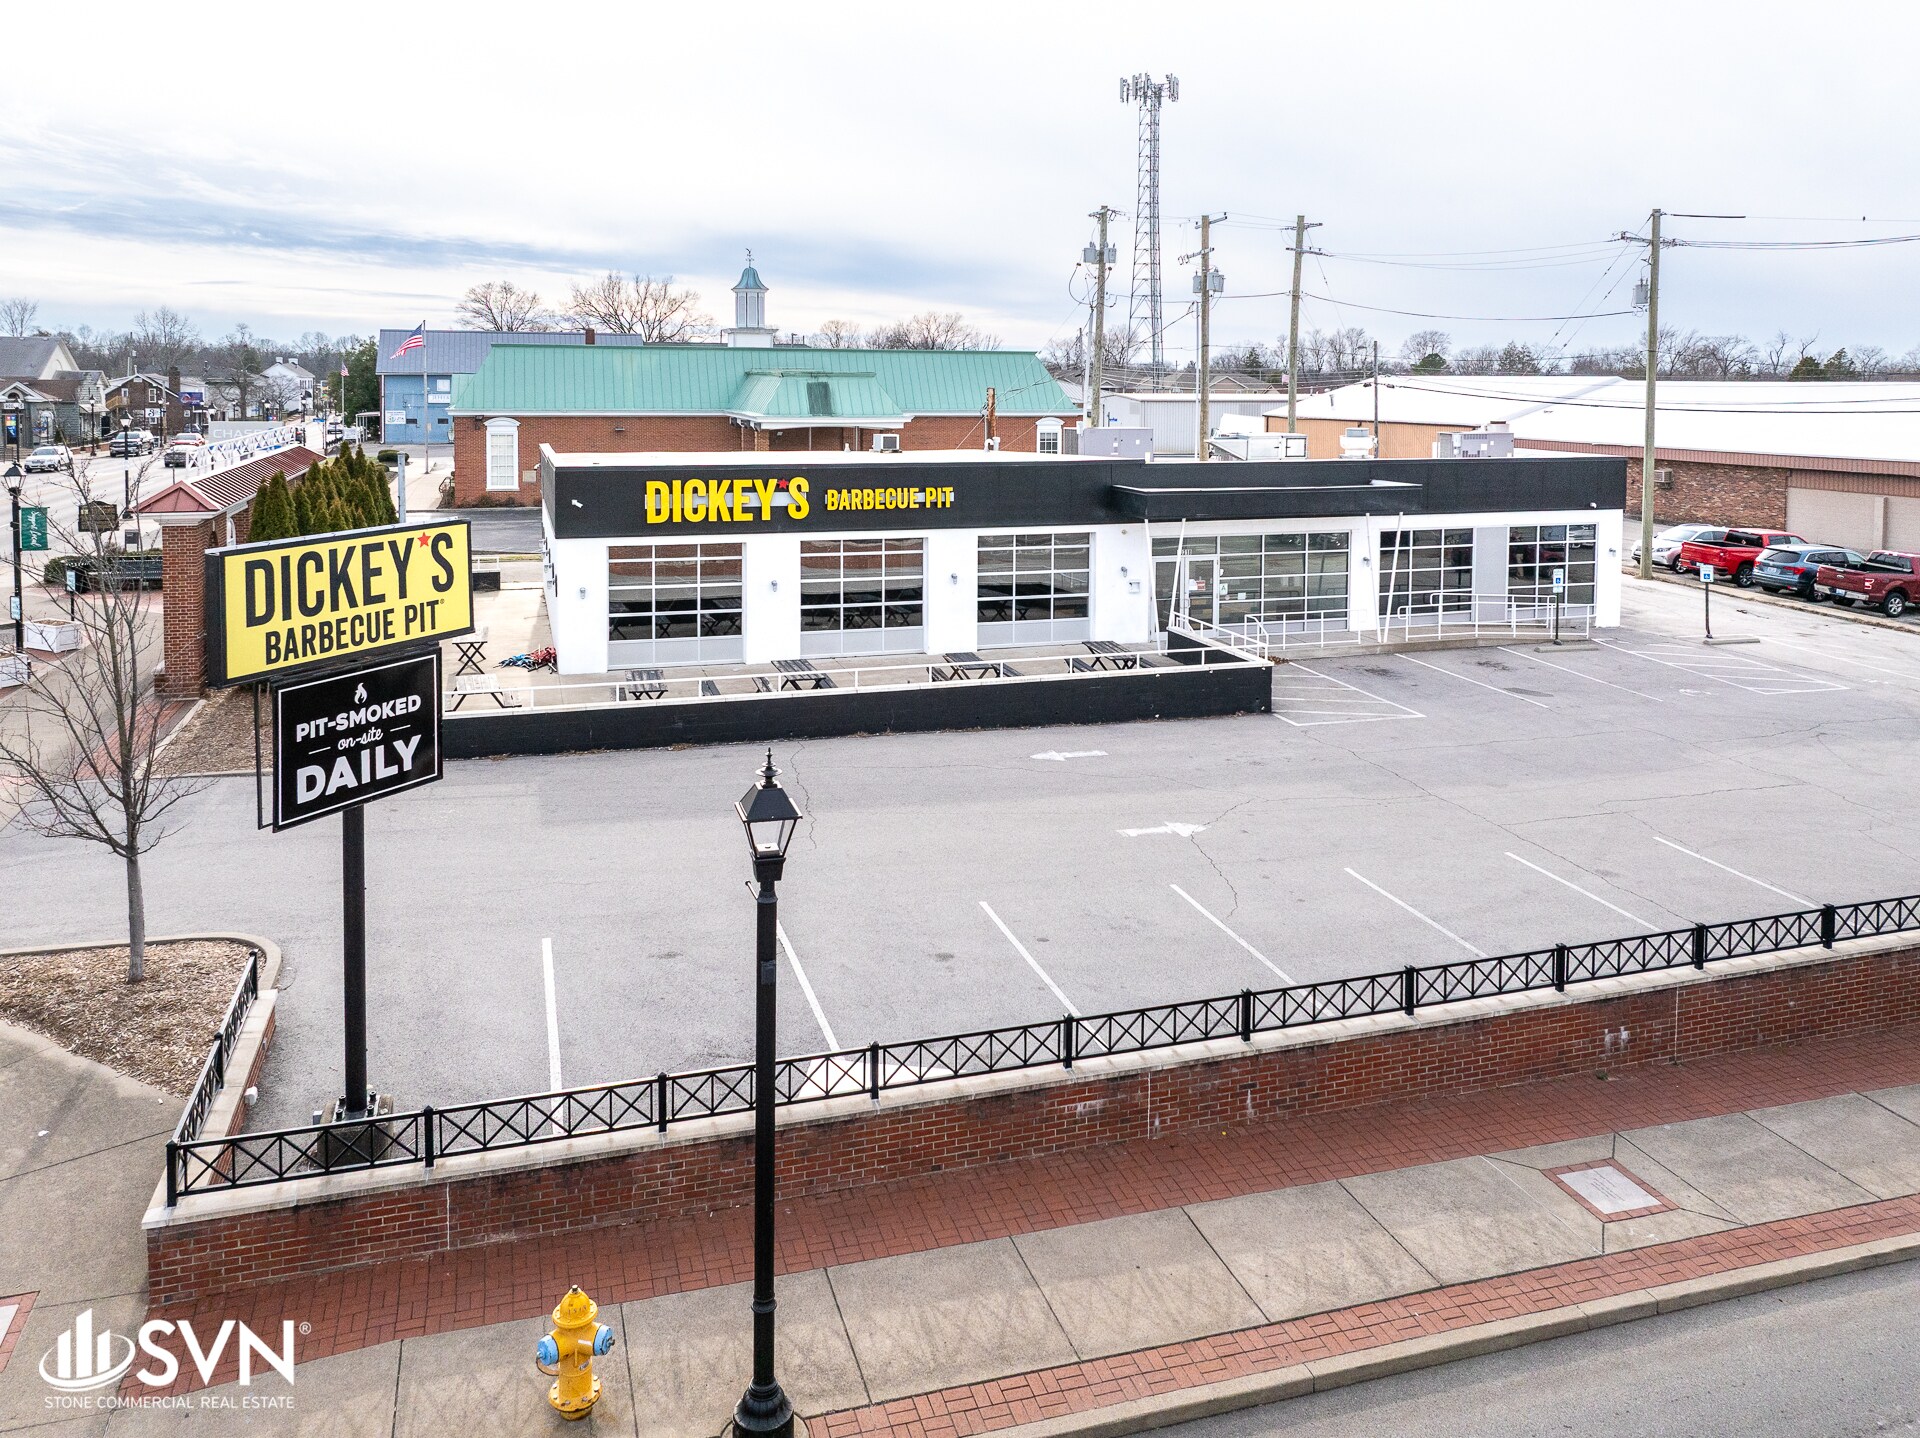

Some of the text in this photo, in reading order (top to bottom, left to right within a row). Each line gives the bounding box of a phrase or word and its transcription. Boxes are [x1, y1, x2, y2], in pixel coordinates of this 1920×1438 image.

[645, 477, 810, 524] DICKEY'S
[827, 486, 954, 511] BARBECUE PIT
[245, 531, 455, 628] DICKEY'S
[266, 607, 396, 666] BARBECUE
[297, 694, 422, 743] PIT-SMOKED
[337, 726, 384, 751] on-site
[297, 734, 422, 804] DAILY
